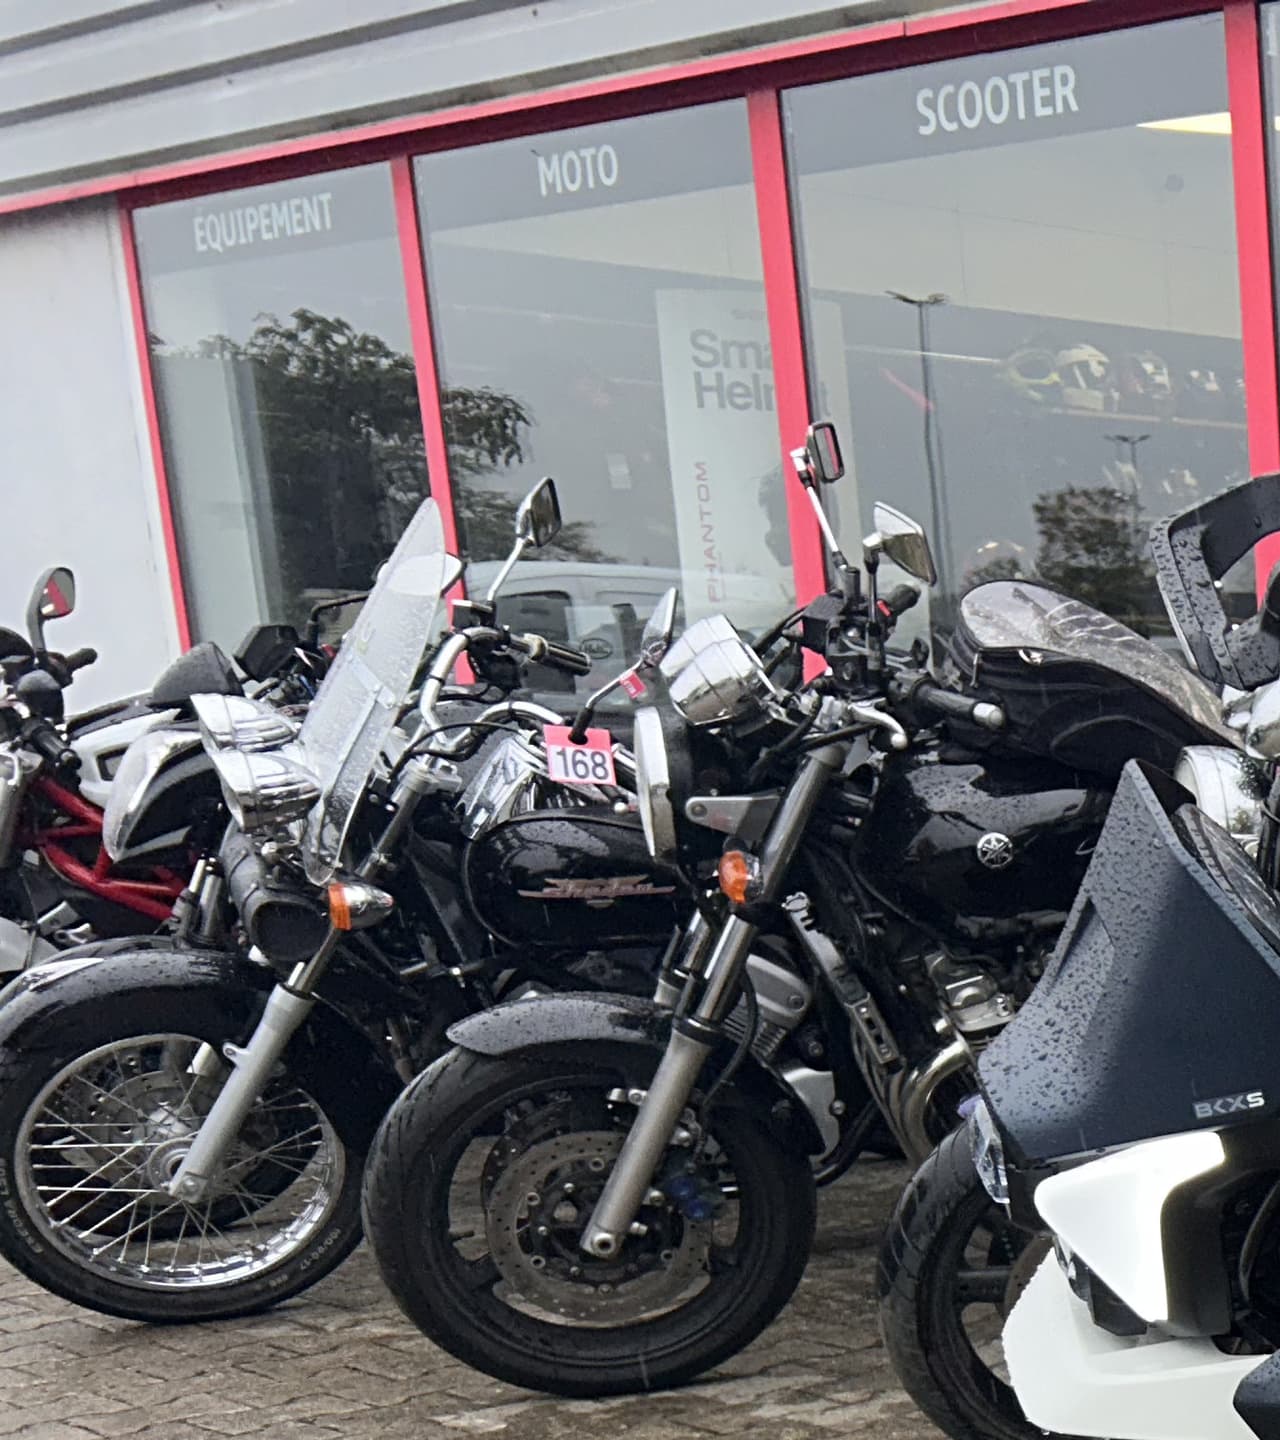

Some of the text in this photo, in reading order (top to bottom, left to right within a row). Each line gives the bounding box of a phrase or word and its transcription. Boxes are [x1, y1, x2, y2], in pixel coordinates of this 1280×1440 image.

[916, 64, 1079, 136] SCOOTER
[537, 143, 618, 197] MOTO
[694, 461, 722, 604] PHANTOM
[556, 748, 609, 781] 168
